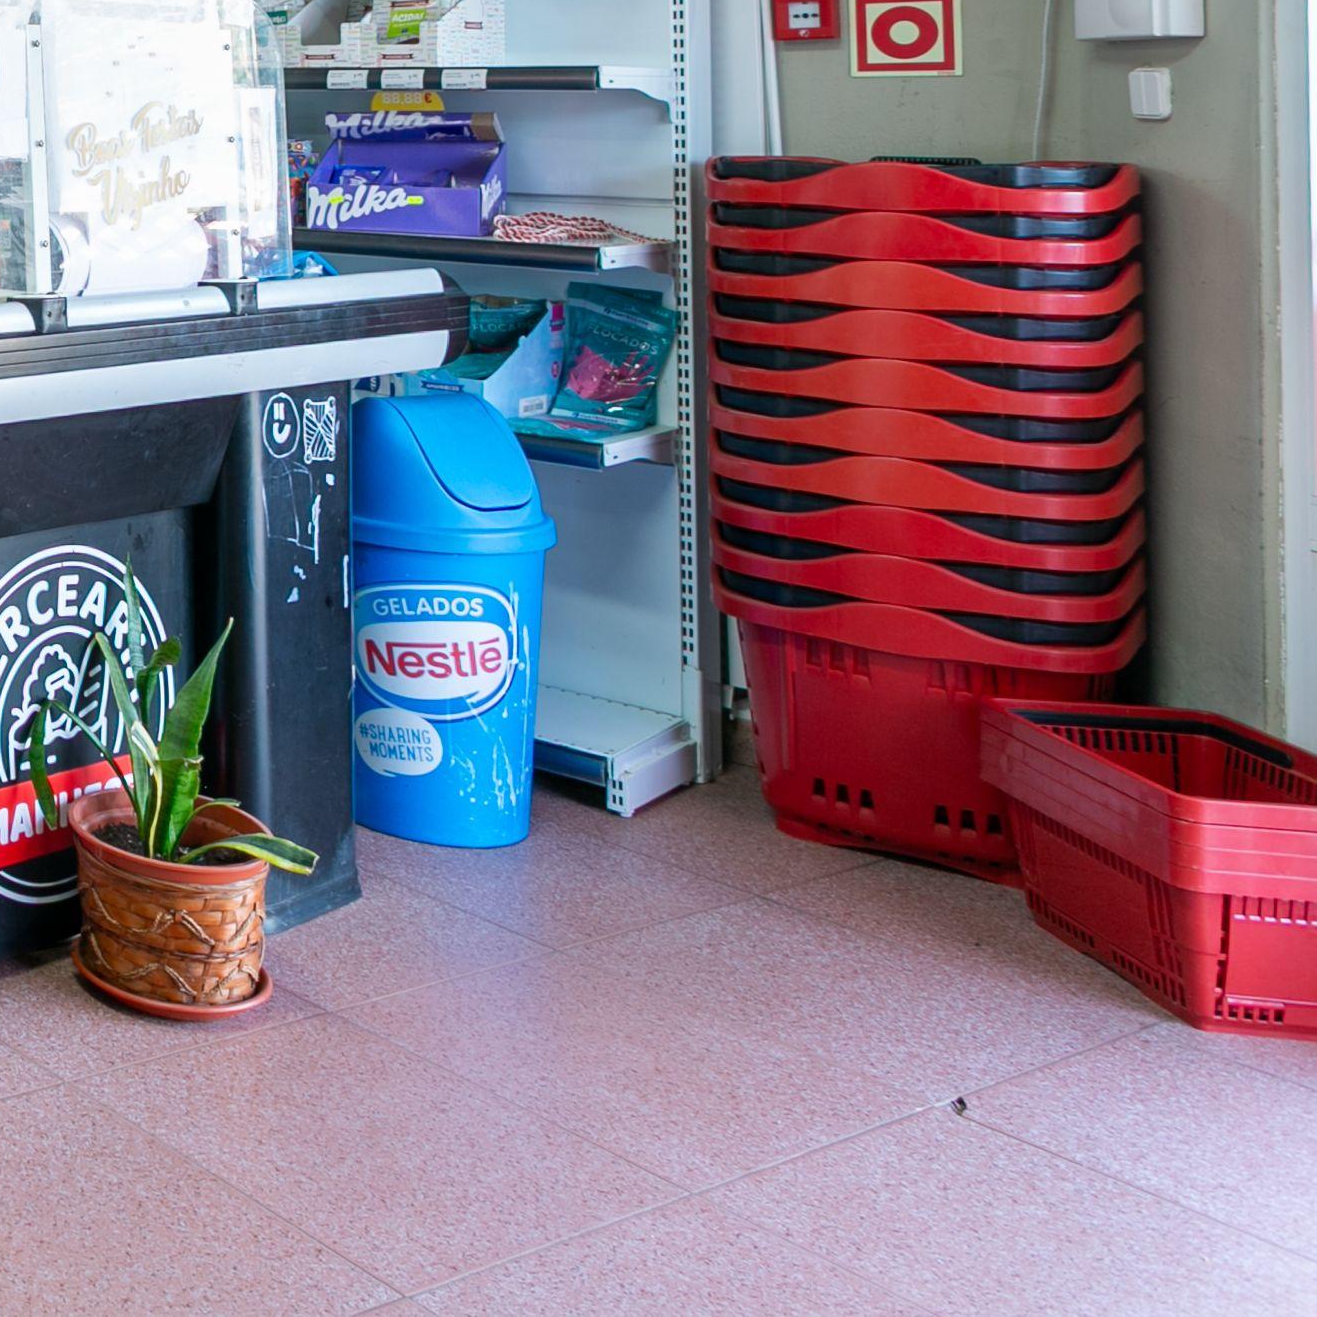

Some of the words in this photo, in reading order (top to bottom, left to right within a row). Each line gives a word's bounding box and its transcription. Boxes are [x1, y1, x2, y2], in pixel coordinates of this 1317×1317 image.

[325, 110, 432, 139] Milka
[307, 185, 409, 229] Milka
[588, 322, 658, 356] FLOCADOS
[373, 597, 484, 617] GELADOS
[365, 637, 502, 679] Nestlé
[359, 722, 431, 745] #SHARING
[370, 742, 434, 763] MOMENTS
